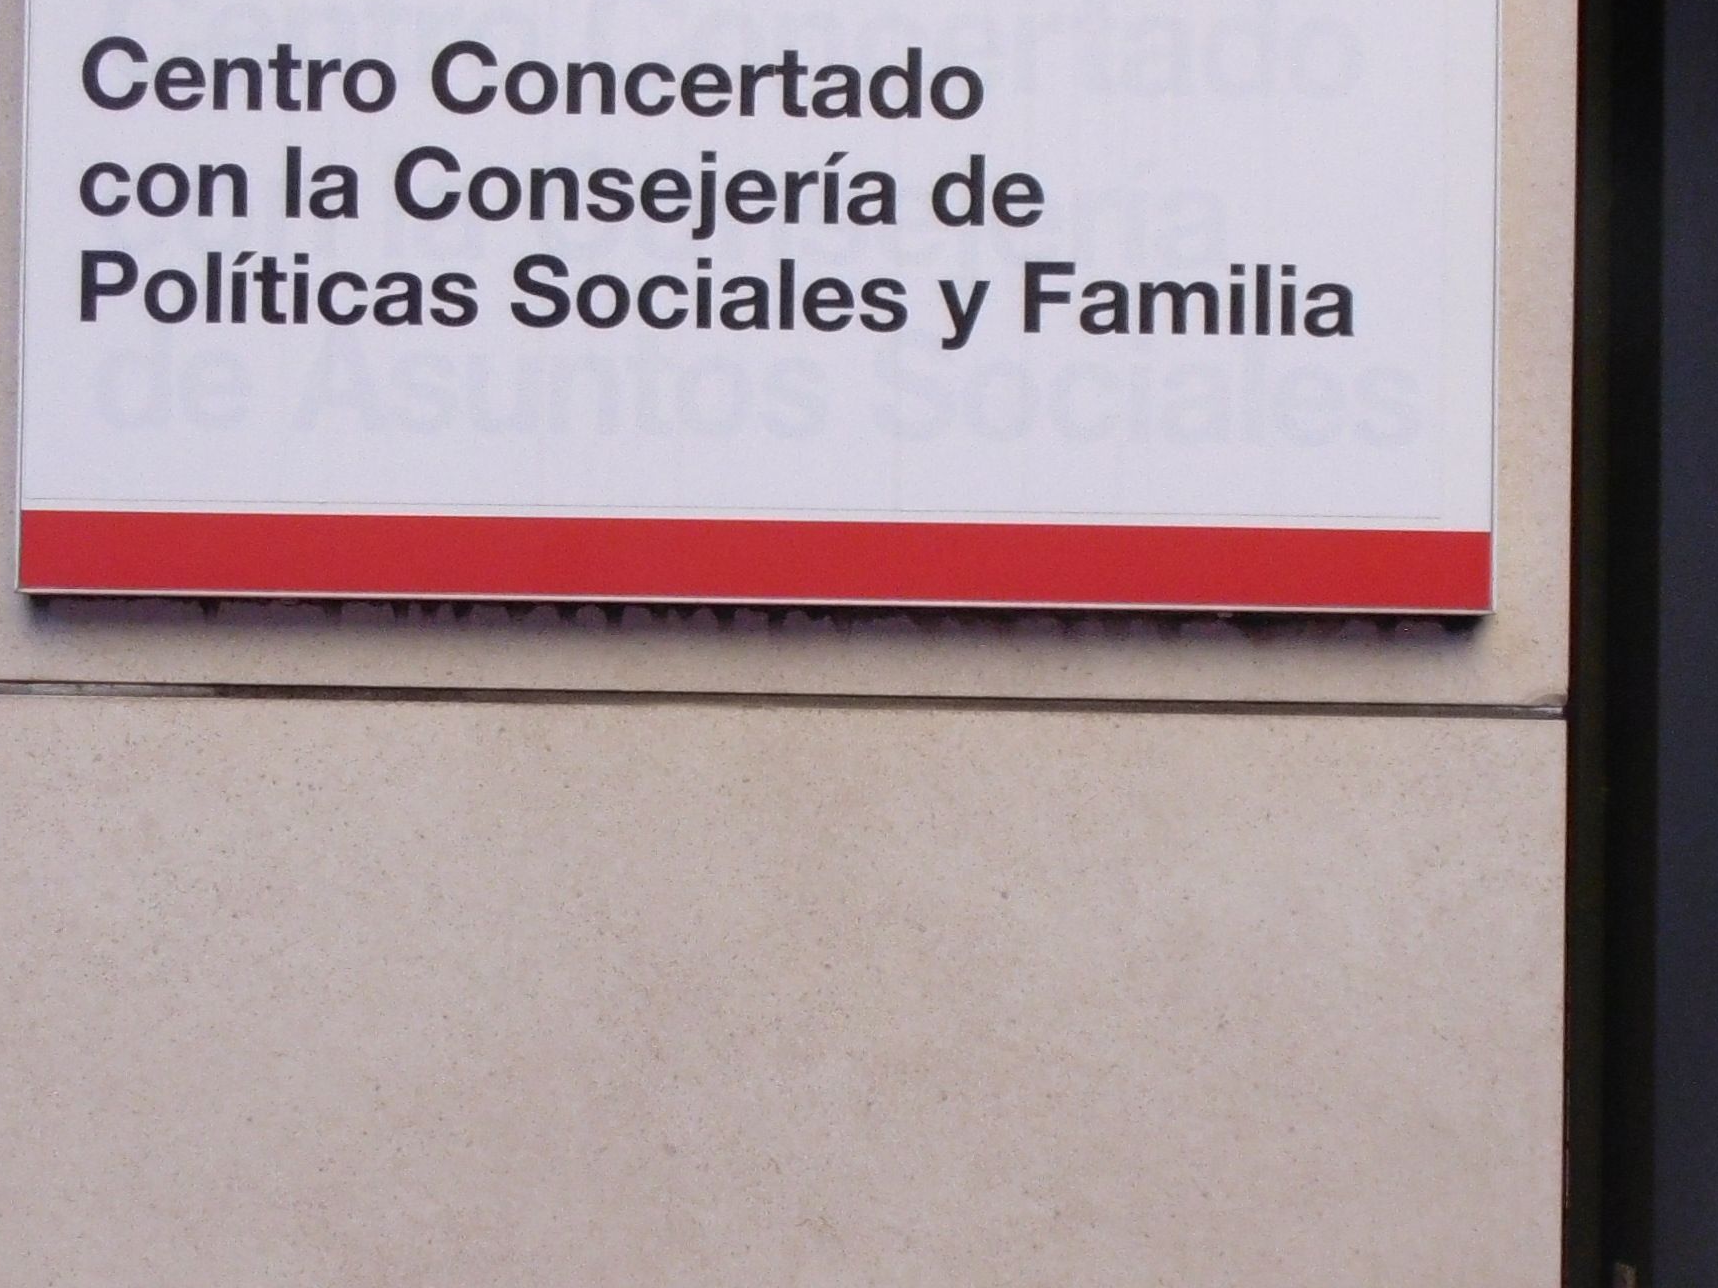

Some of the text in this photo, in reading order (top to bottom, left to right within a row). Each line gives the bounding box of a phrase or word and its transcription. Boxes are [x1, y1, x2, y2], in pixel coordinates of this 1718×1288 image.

[82, 36, 984, 120] Centro Concertado
[79, 161, 248, 218] con
[285, 145, 359, 220] la
[394, 145, 897, 241] Consejería
[931, 154, 1045, 228] de
[80, 249, 1353, 351] Políticas Sociales y Familia
